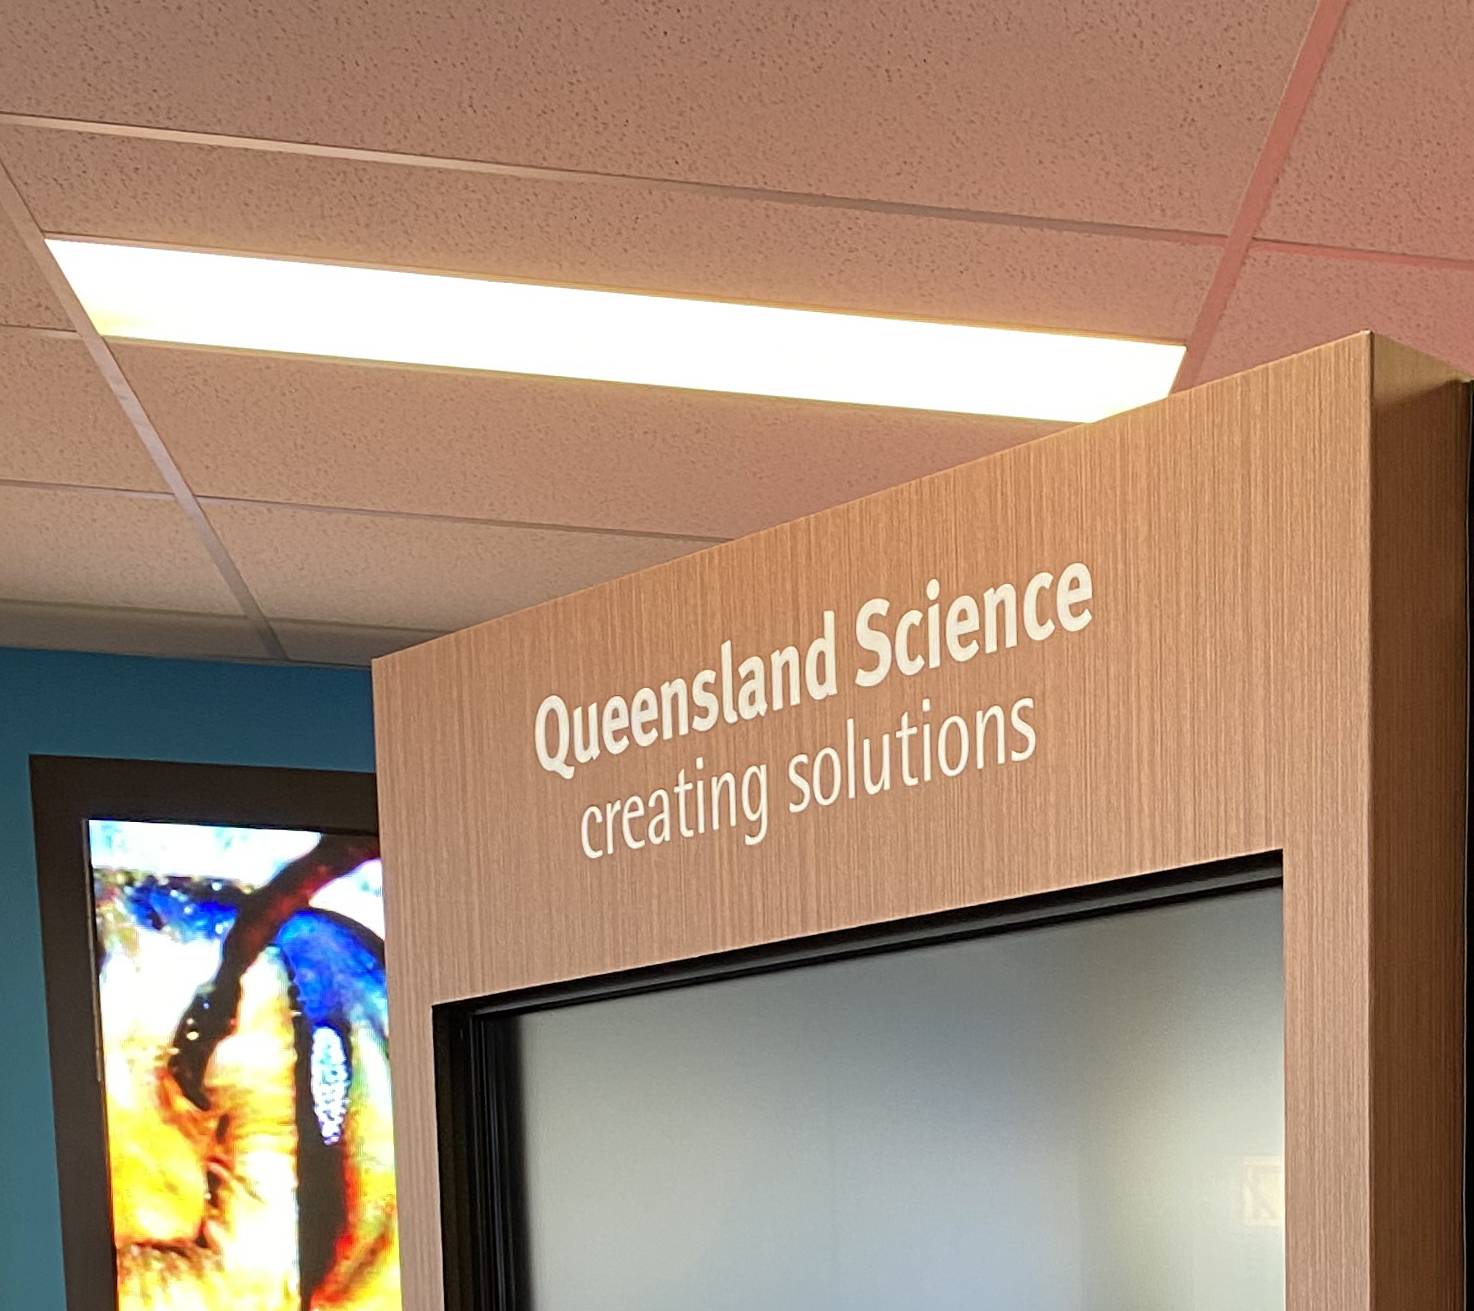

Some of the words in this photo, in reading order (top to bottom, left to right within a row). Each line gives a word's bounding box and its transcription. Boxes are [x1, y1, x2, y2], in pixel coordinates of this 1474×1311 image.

[534, 611, 838, 779] Queensland
[855, 561, 1094, 688] Science
[580, 756, 769, 859] creating
[788, 697, 1038, 814] solutions
